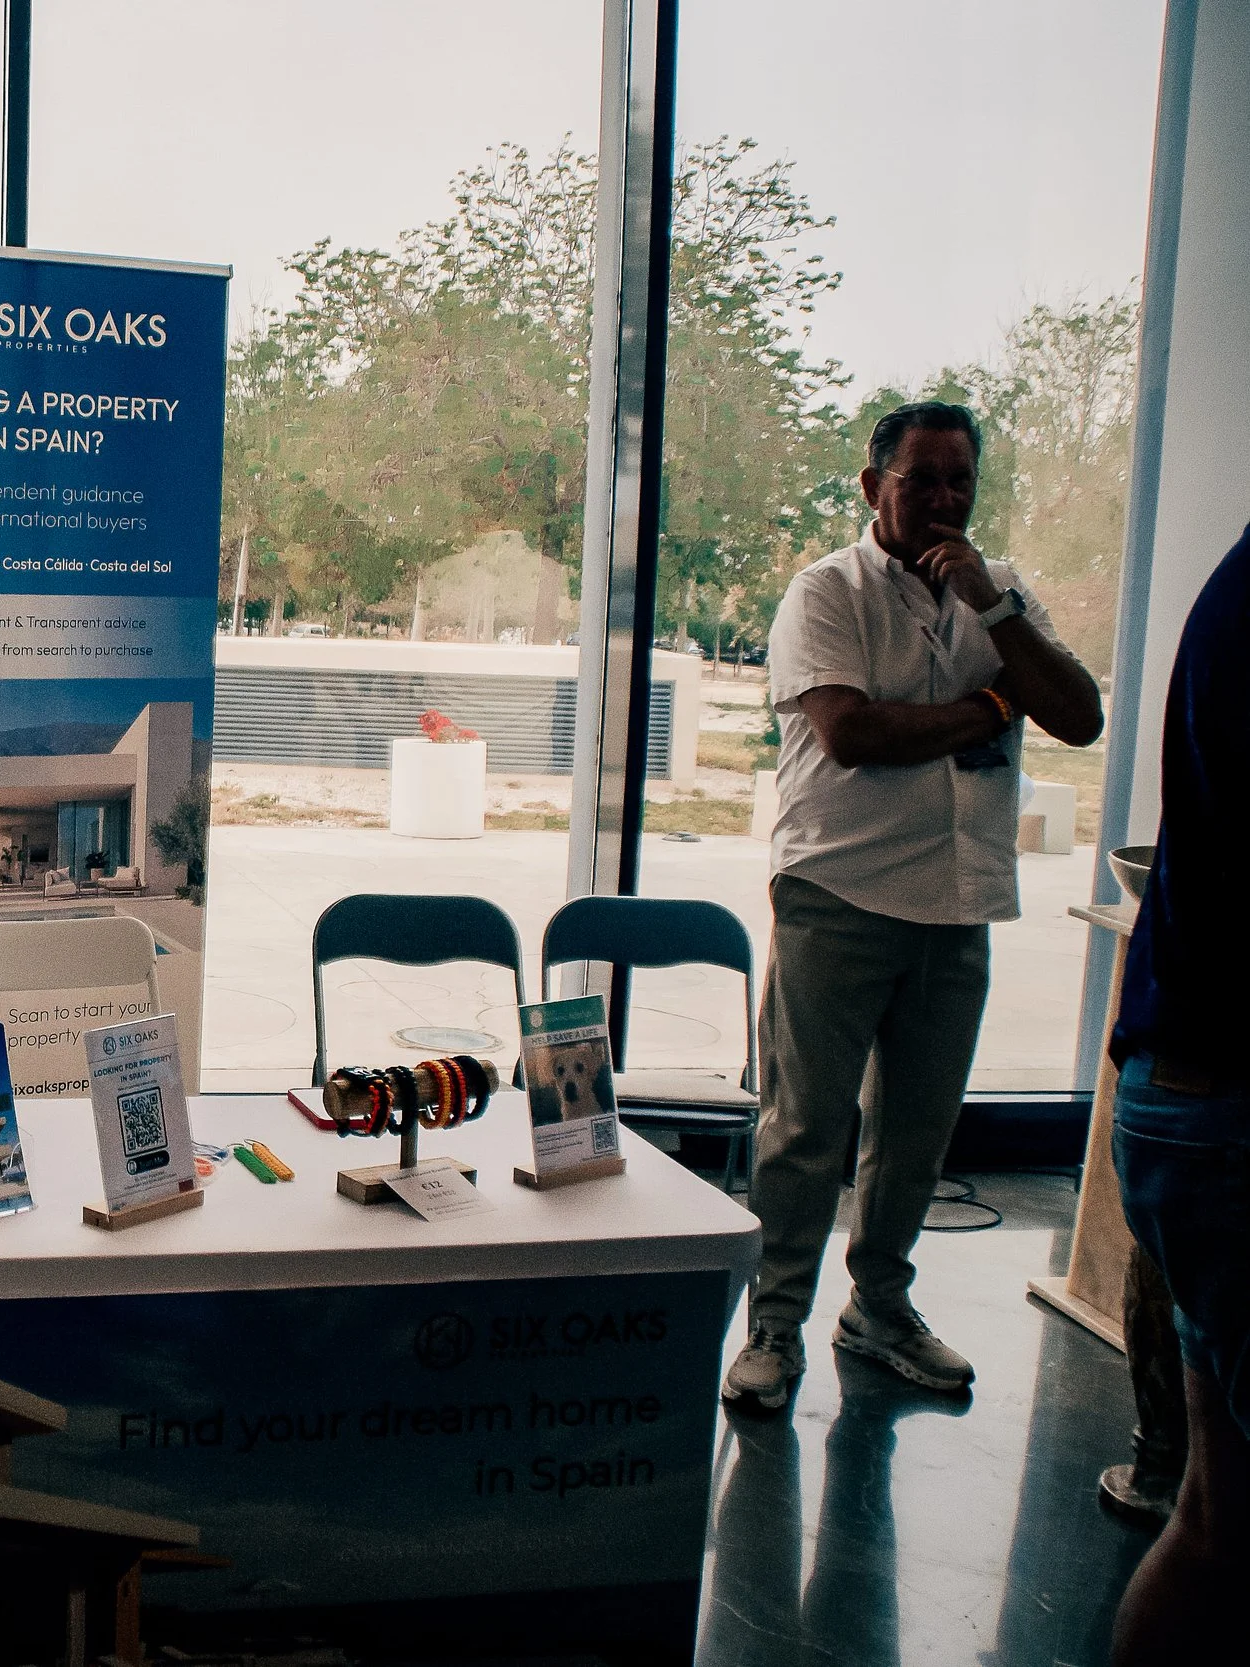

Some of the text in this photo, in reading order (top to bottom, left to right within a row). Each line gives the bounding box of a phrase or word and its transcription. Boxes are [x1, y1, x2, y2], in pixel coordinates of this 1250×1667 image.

[65, 308, 166, 347] OAKS
[16, 391, 35, 414] A
[43, 392, 179, 422] PROPERTY
[15, 428, 104, 454] SPAIN?
[62, 485, 144, 505] guidance
[87, 512, 147, 533] buyers
[2, 557, 41, 570] Costa
[44, 556, 83, 571] Cálida
[90, 559, 128, 572] Costa
[130, 560, 150, 572] del
[153, 560, 172, 573] Sol
[14, 616, 24, 628] &
[27, 616, 101, 630] Transparent
[104, 617, 146, 629] advice
[1, 643, 33, 656] from
[36, 643, 77, 656] search
[80, 644, 92, 656] to
[95, 643, 153, 659] purchase
[8, 1001, 151, 1024] Scan to start your
[8, 1028, 81, 1051] property
[119, 1029, 159, 1047] SIX OAKS
[93, 1053, 173, 1078] LOOKING FOR PROPERTY
[12, 1079, 89, 1096] ixoaksprop
[421, 1180, 443, 1191] €12
[489, 1309, 667, 1350] SIX OAKS
[119, 1392, 662, 1453] Find your dream home
[475, 1449, 655, 1499] in Spain
